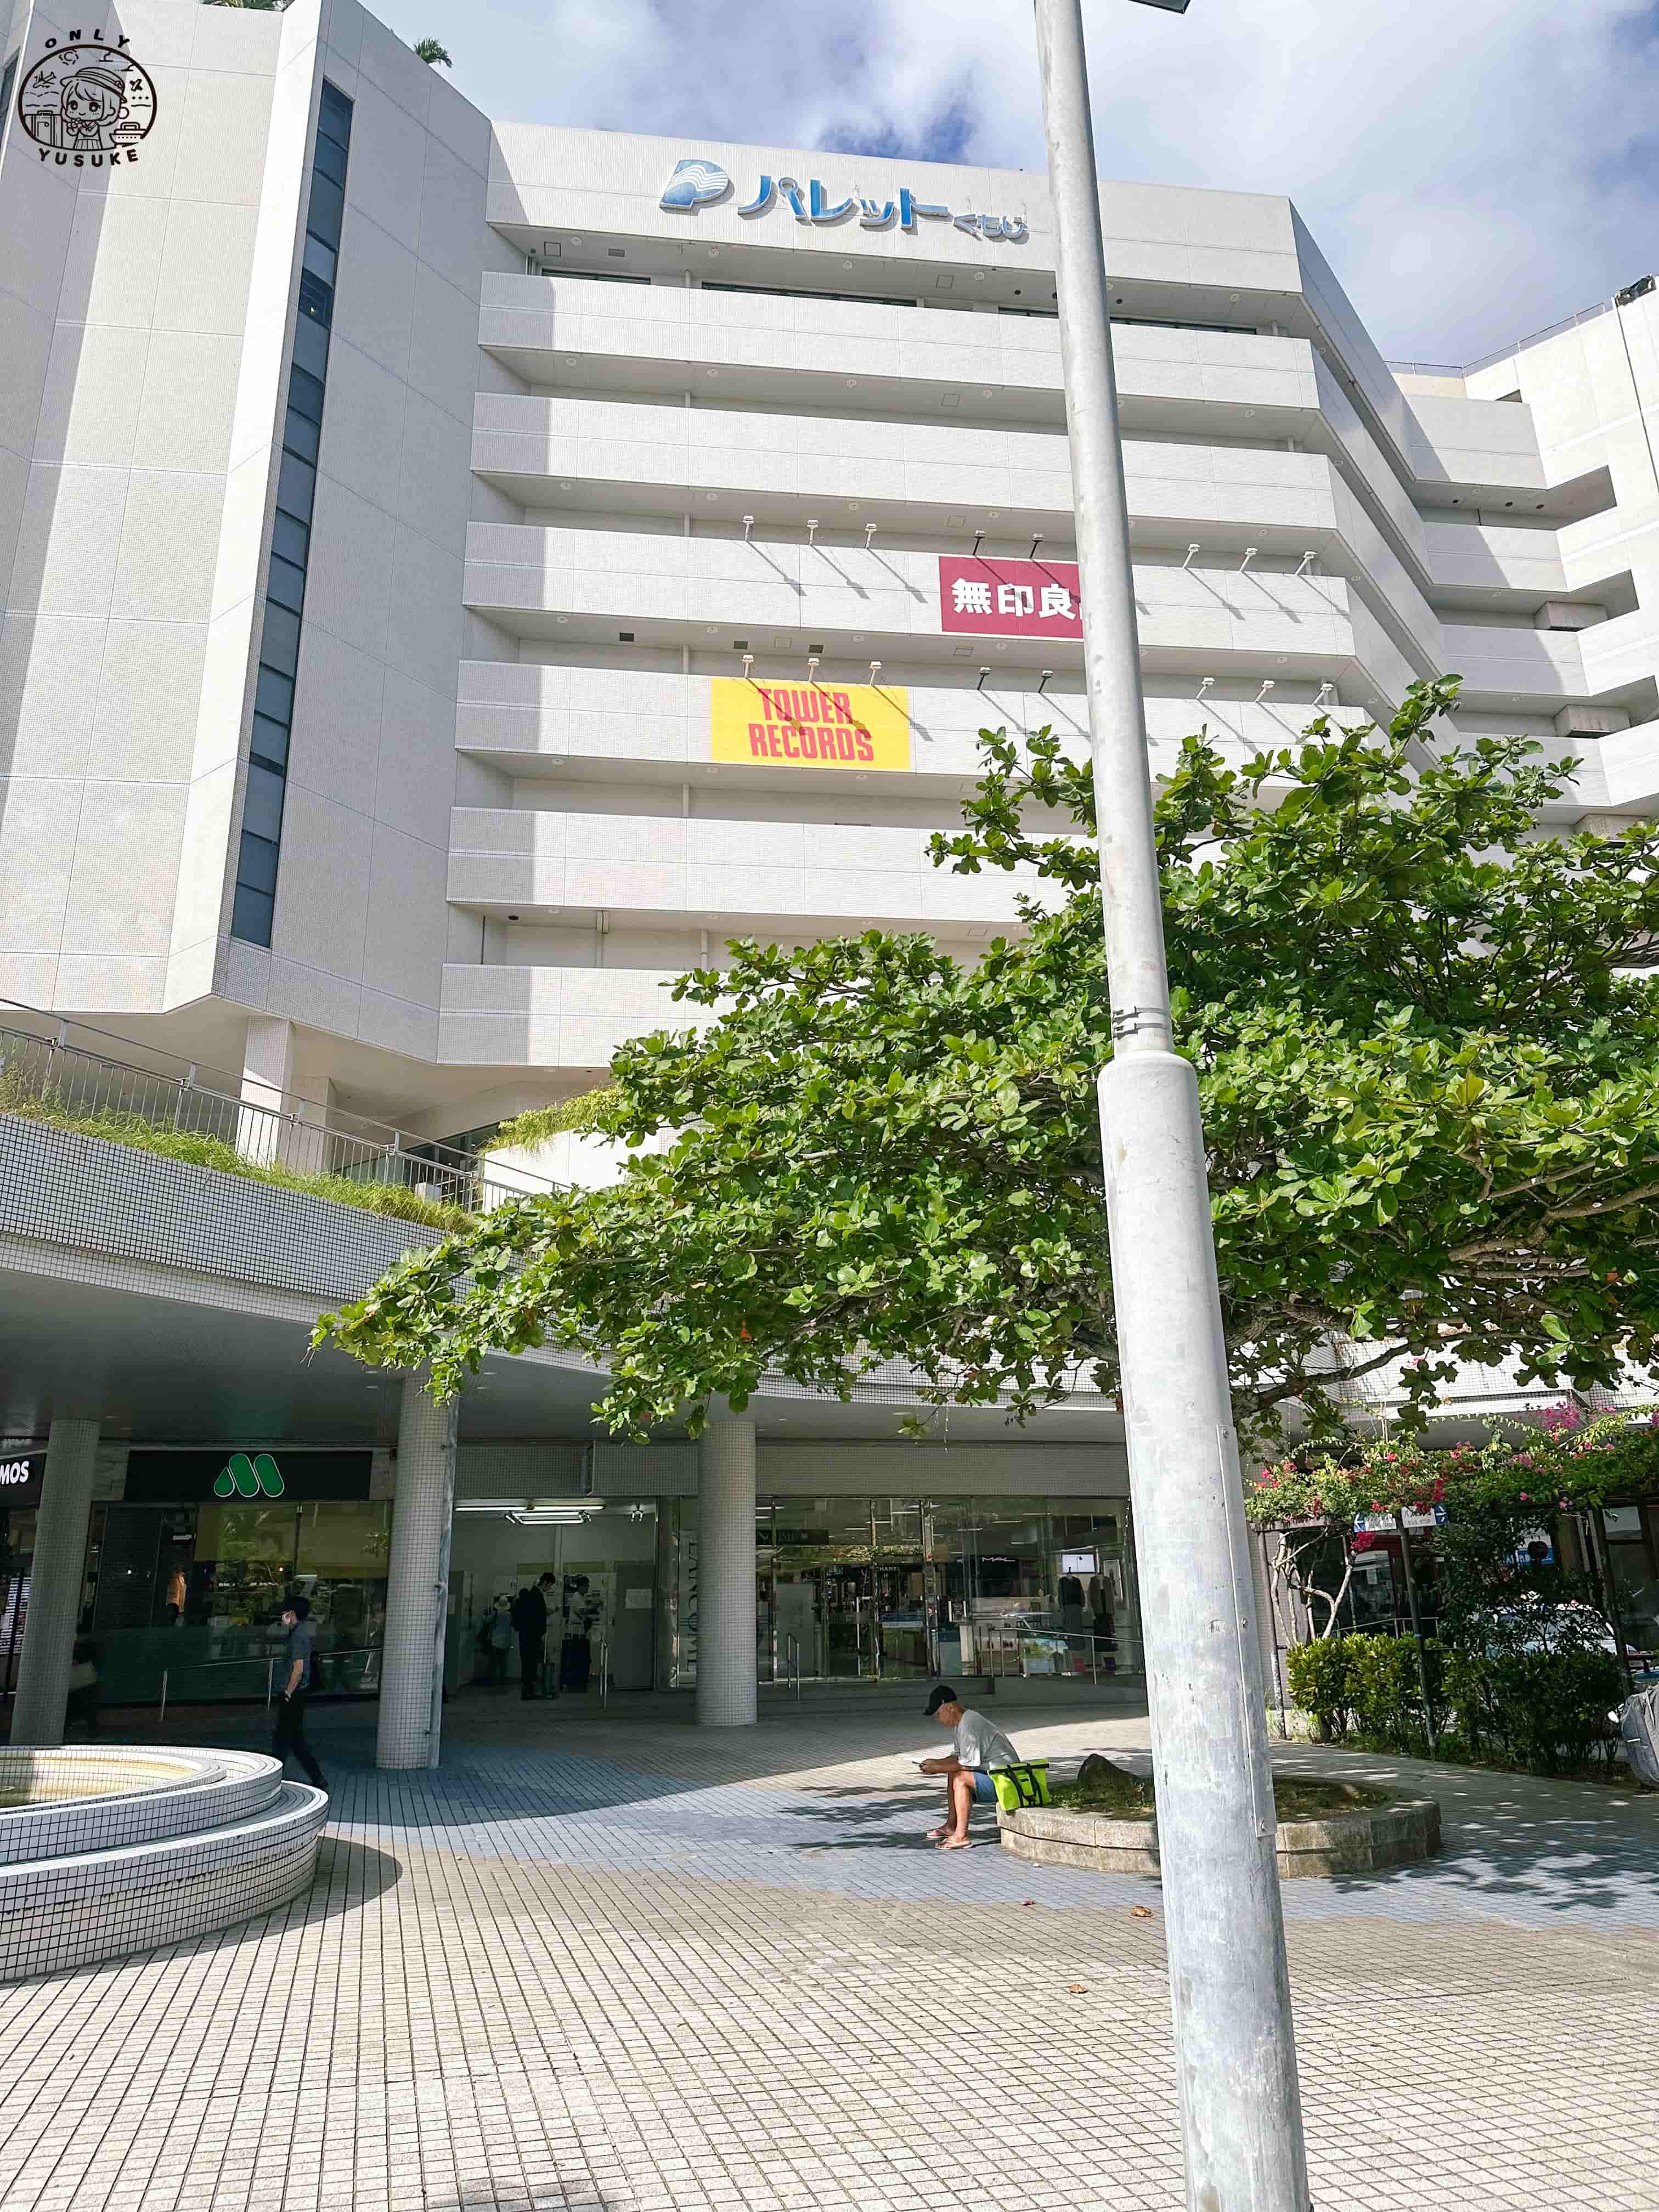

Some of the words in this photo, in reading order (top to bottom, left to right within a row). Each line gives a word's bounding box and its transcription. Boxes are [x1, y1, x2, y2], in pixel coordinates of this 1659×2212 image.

[951, 578, 1082, 620] 無印良
[759, 688, 853, 725] TOWER
[748, 724, 874, 761] RECORDS
[0, 1460, 30, 1485] MOS
